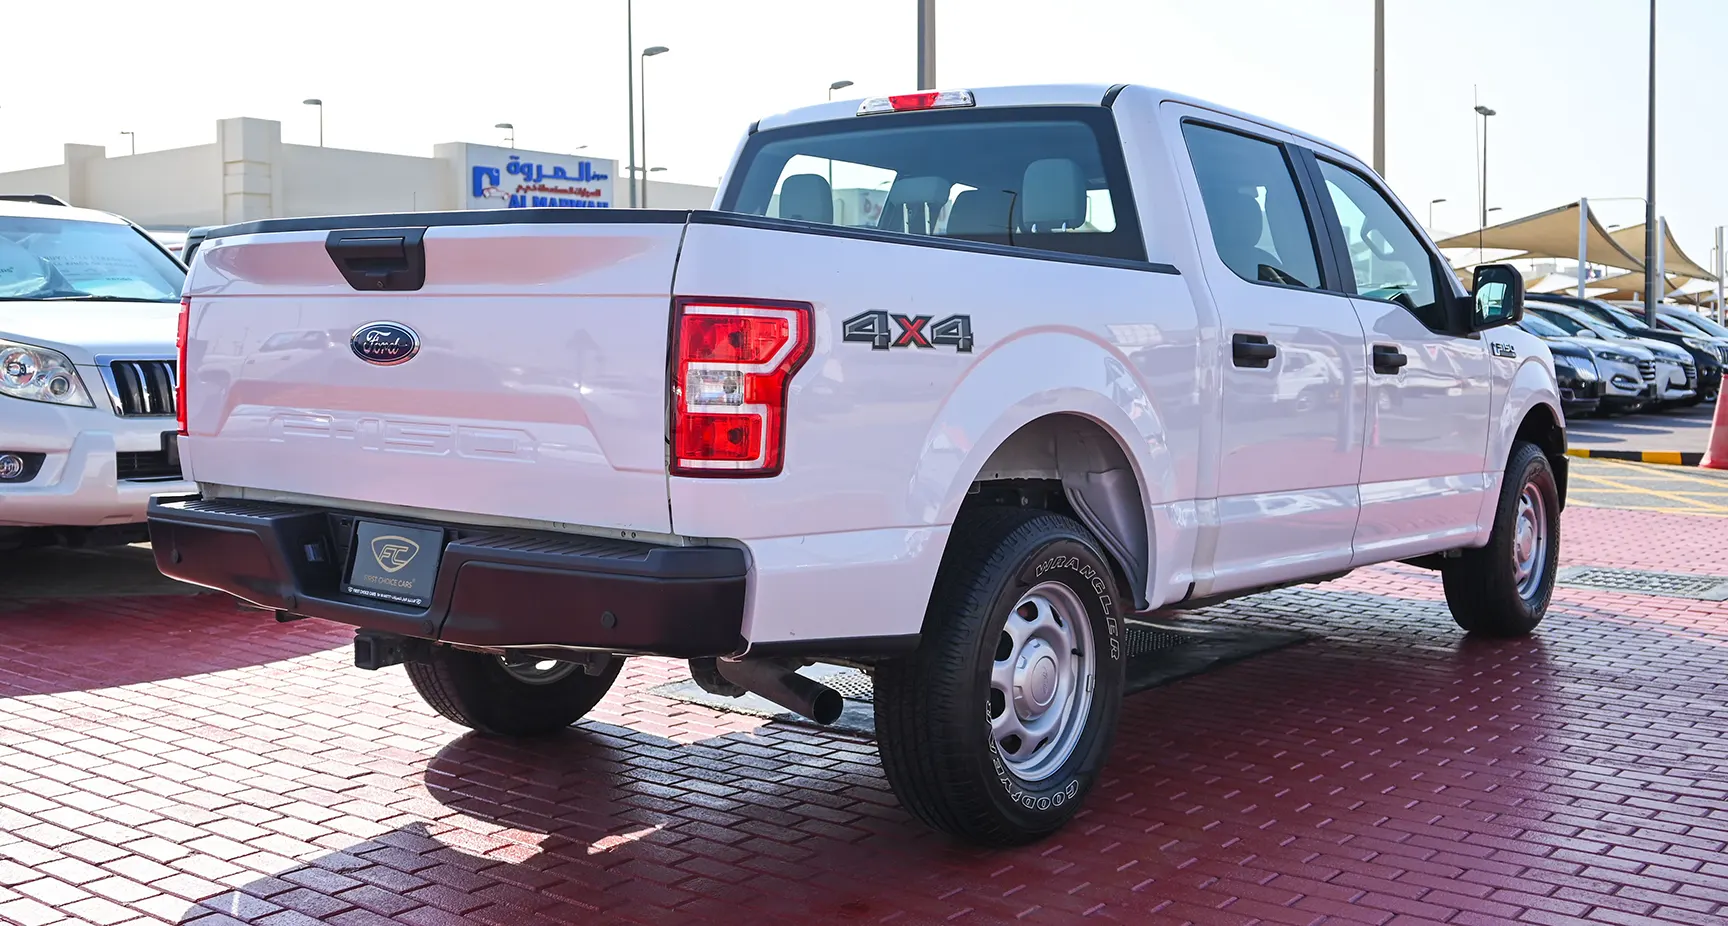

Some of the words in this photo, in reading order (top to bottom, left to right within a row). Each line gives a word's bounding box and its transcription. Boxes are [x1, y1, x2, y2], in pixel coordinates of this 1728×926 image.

[363, 330, 401, 355] Ford
[398, 579, 412, 589] CARS
[1035, 556, 1121, 661] WRANGLER
